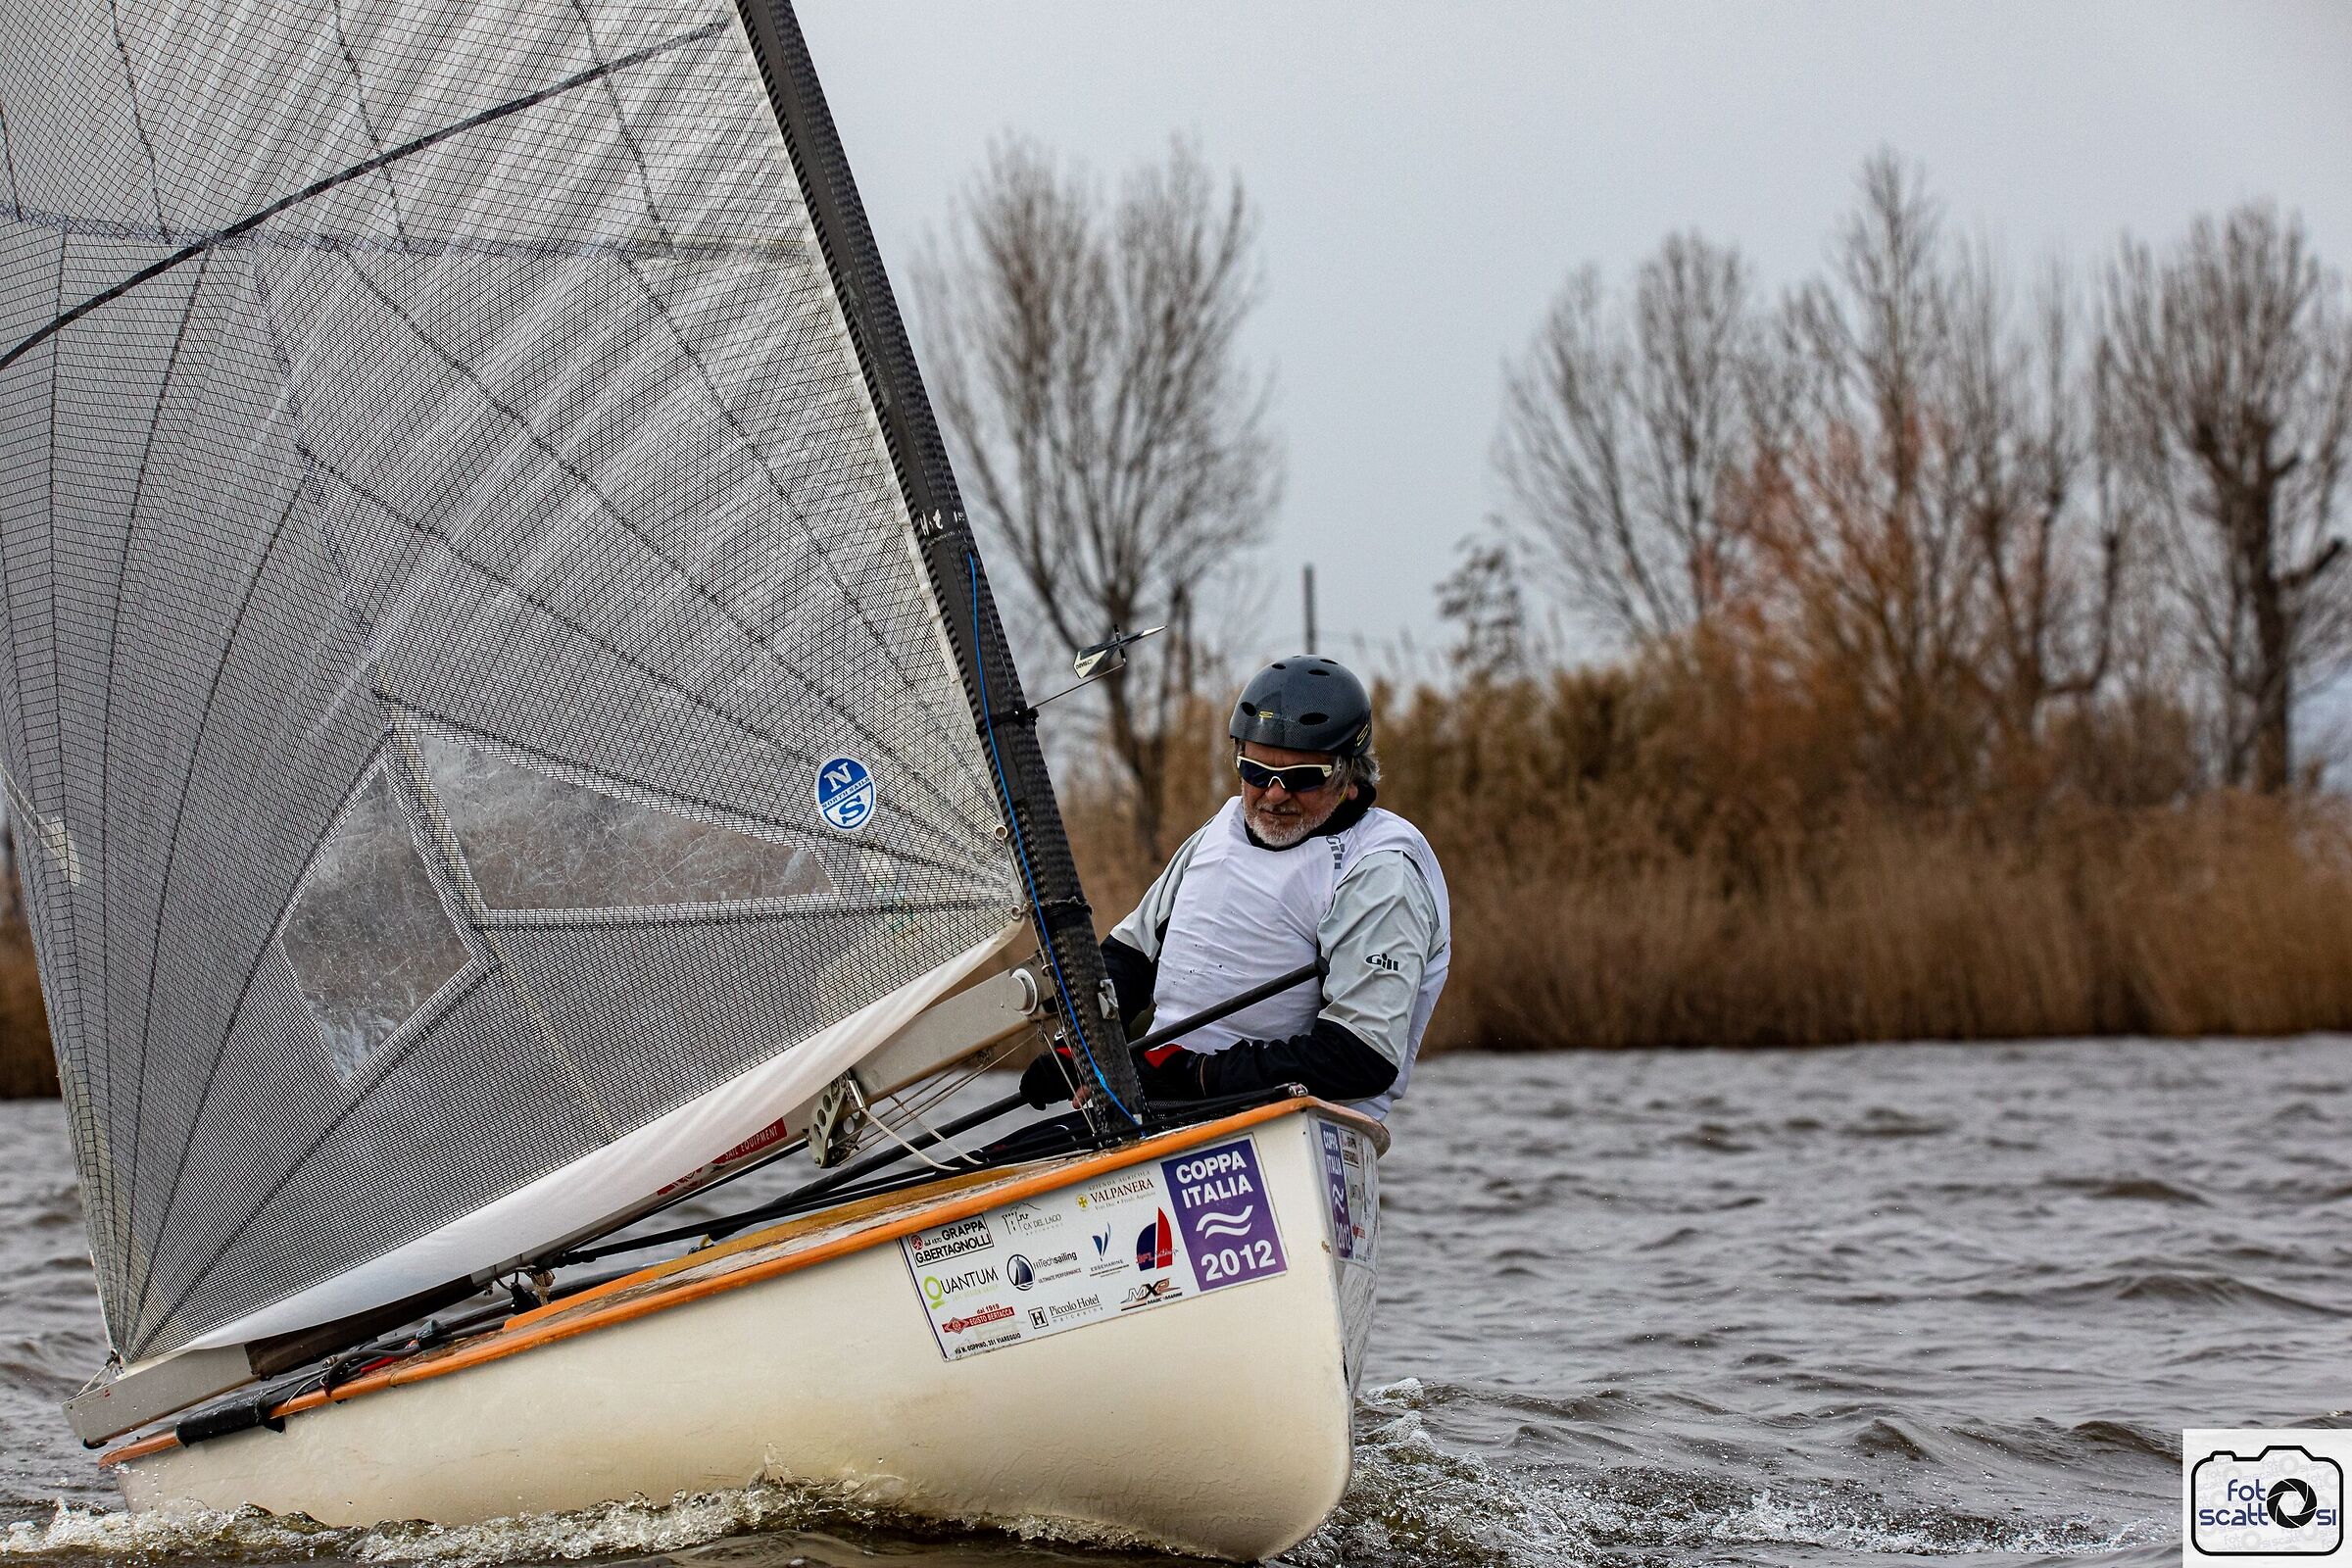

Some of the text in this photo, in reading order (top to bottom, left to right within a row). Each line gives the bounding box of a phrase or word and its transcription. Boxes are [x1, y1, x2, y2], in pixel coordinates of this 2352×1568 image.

[824, 761, 853, 793] N
[822, 777, 870, 809] NORTH SAILS
[839, 795, 865, 824] S
[1365, 953, 1399, 971] Gill
[741, 1126, 777, 1152] EQUIPMENT
[1176, 1151, 1248, 1184] COPPA
[1090, 1178, 1154, 1202] VALPANERA
[1181, 1174, 1254, 1209] ITALIA
[942, 1220, 986, 1241] GRAPPA
[1033, 1219, 1045, 1228] DEL
[1045, 1213, 1062, 1225] LAGO
[915, 1234, 992, 1264] G.BERTAGNOLLI
[1336, 1222, 1351, 1250] 2012
[1200, 1240, 1276, 1282] 2012
[924, 1266, 1000, 1310] QUANTUM
[969, 1308, 1013, 1326] EGISTO BERTACCA
[1050, 1294, 1101, 1316] Piccolo Hotel
[997, 1333, 1021, 1345] VIAREGGIO
